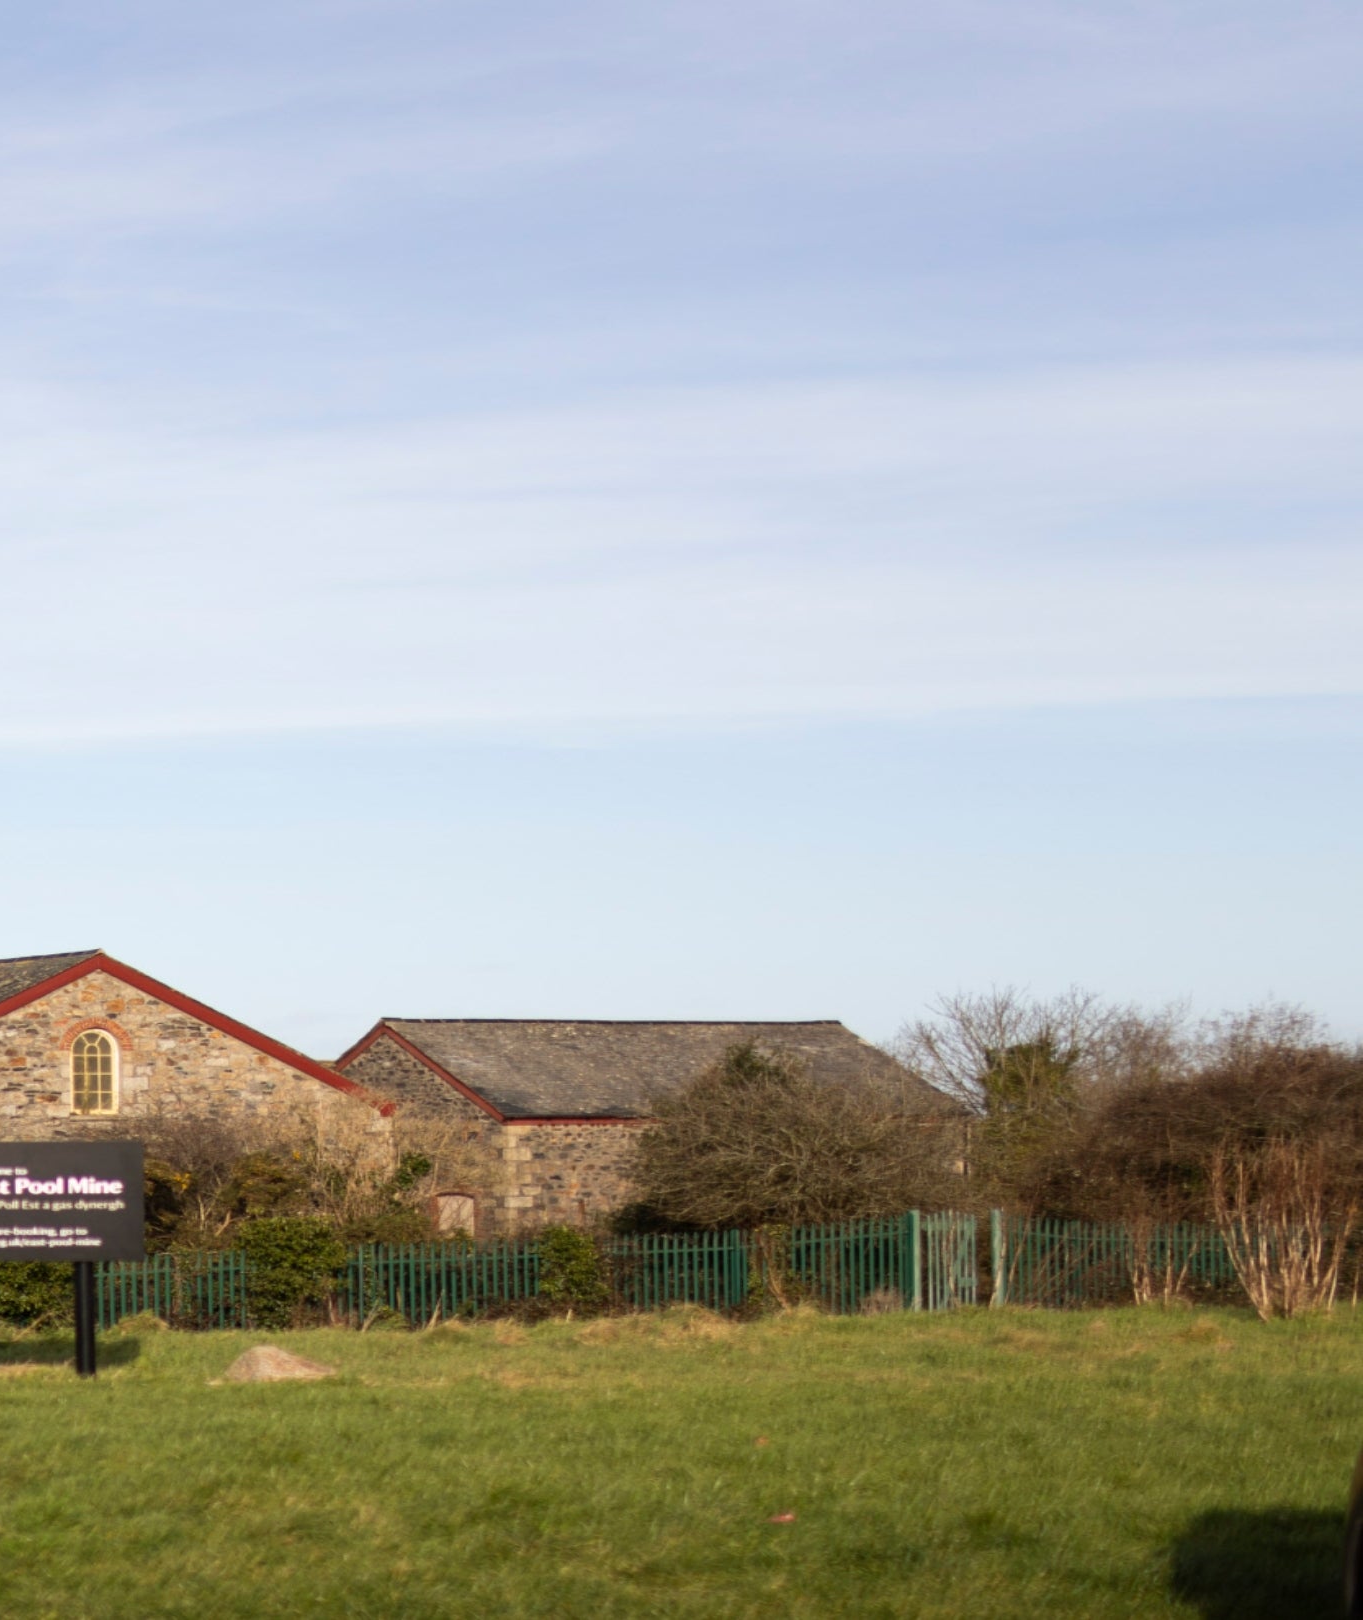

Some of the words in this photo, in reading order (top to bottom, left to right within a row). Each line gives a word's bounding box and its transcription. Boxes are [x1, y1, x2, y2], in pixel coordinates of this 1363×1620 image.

[14, 1165, 28, 1176] to
[14, 1176, 64, 1196] Pool
[67, 1176, 124, 1196] Mine
[21, 1200, 41, 1211] Est
[42, 1202, 51, 1211] a
[51, 1202, 73, 1212] gas
[74, 1199, 125, 1212] dynergh
[59, 1228, 74, 1238] go
[75, 1227, 89, 1236] to
